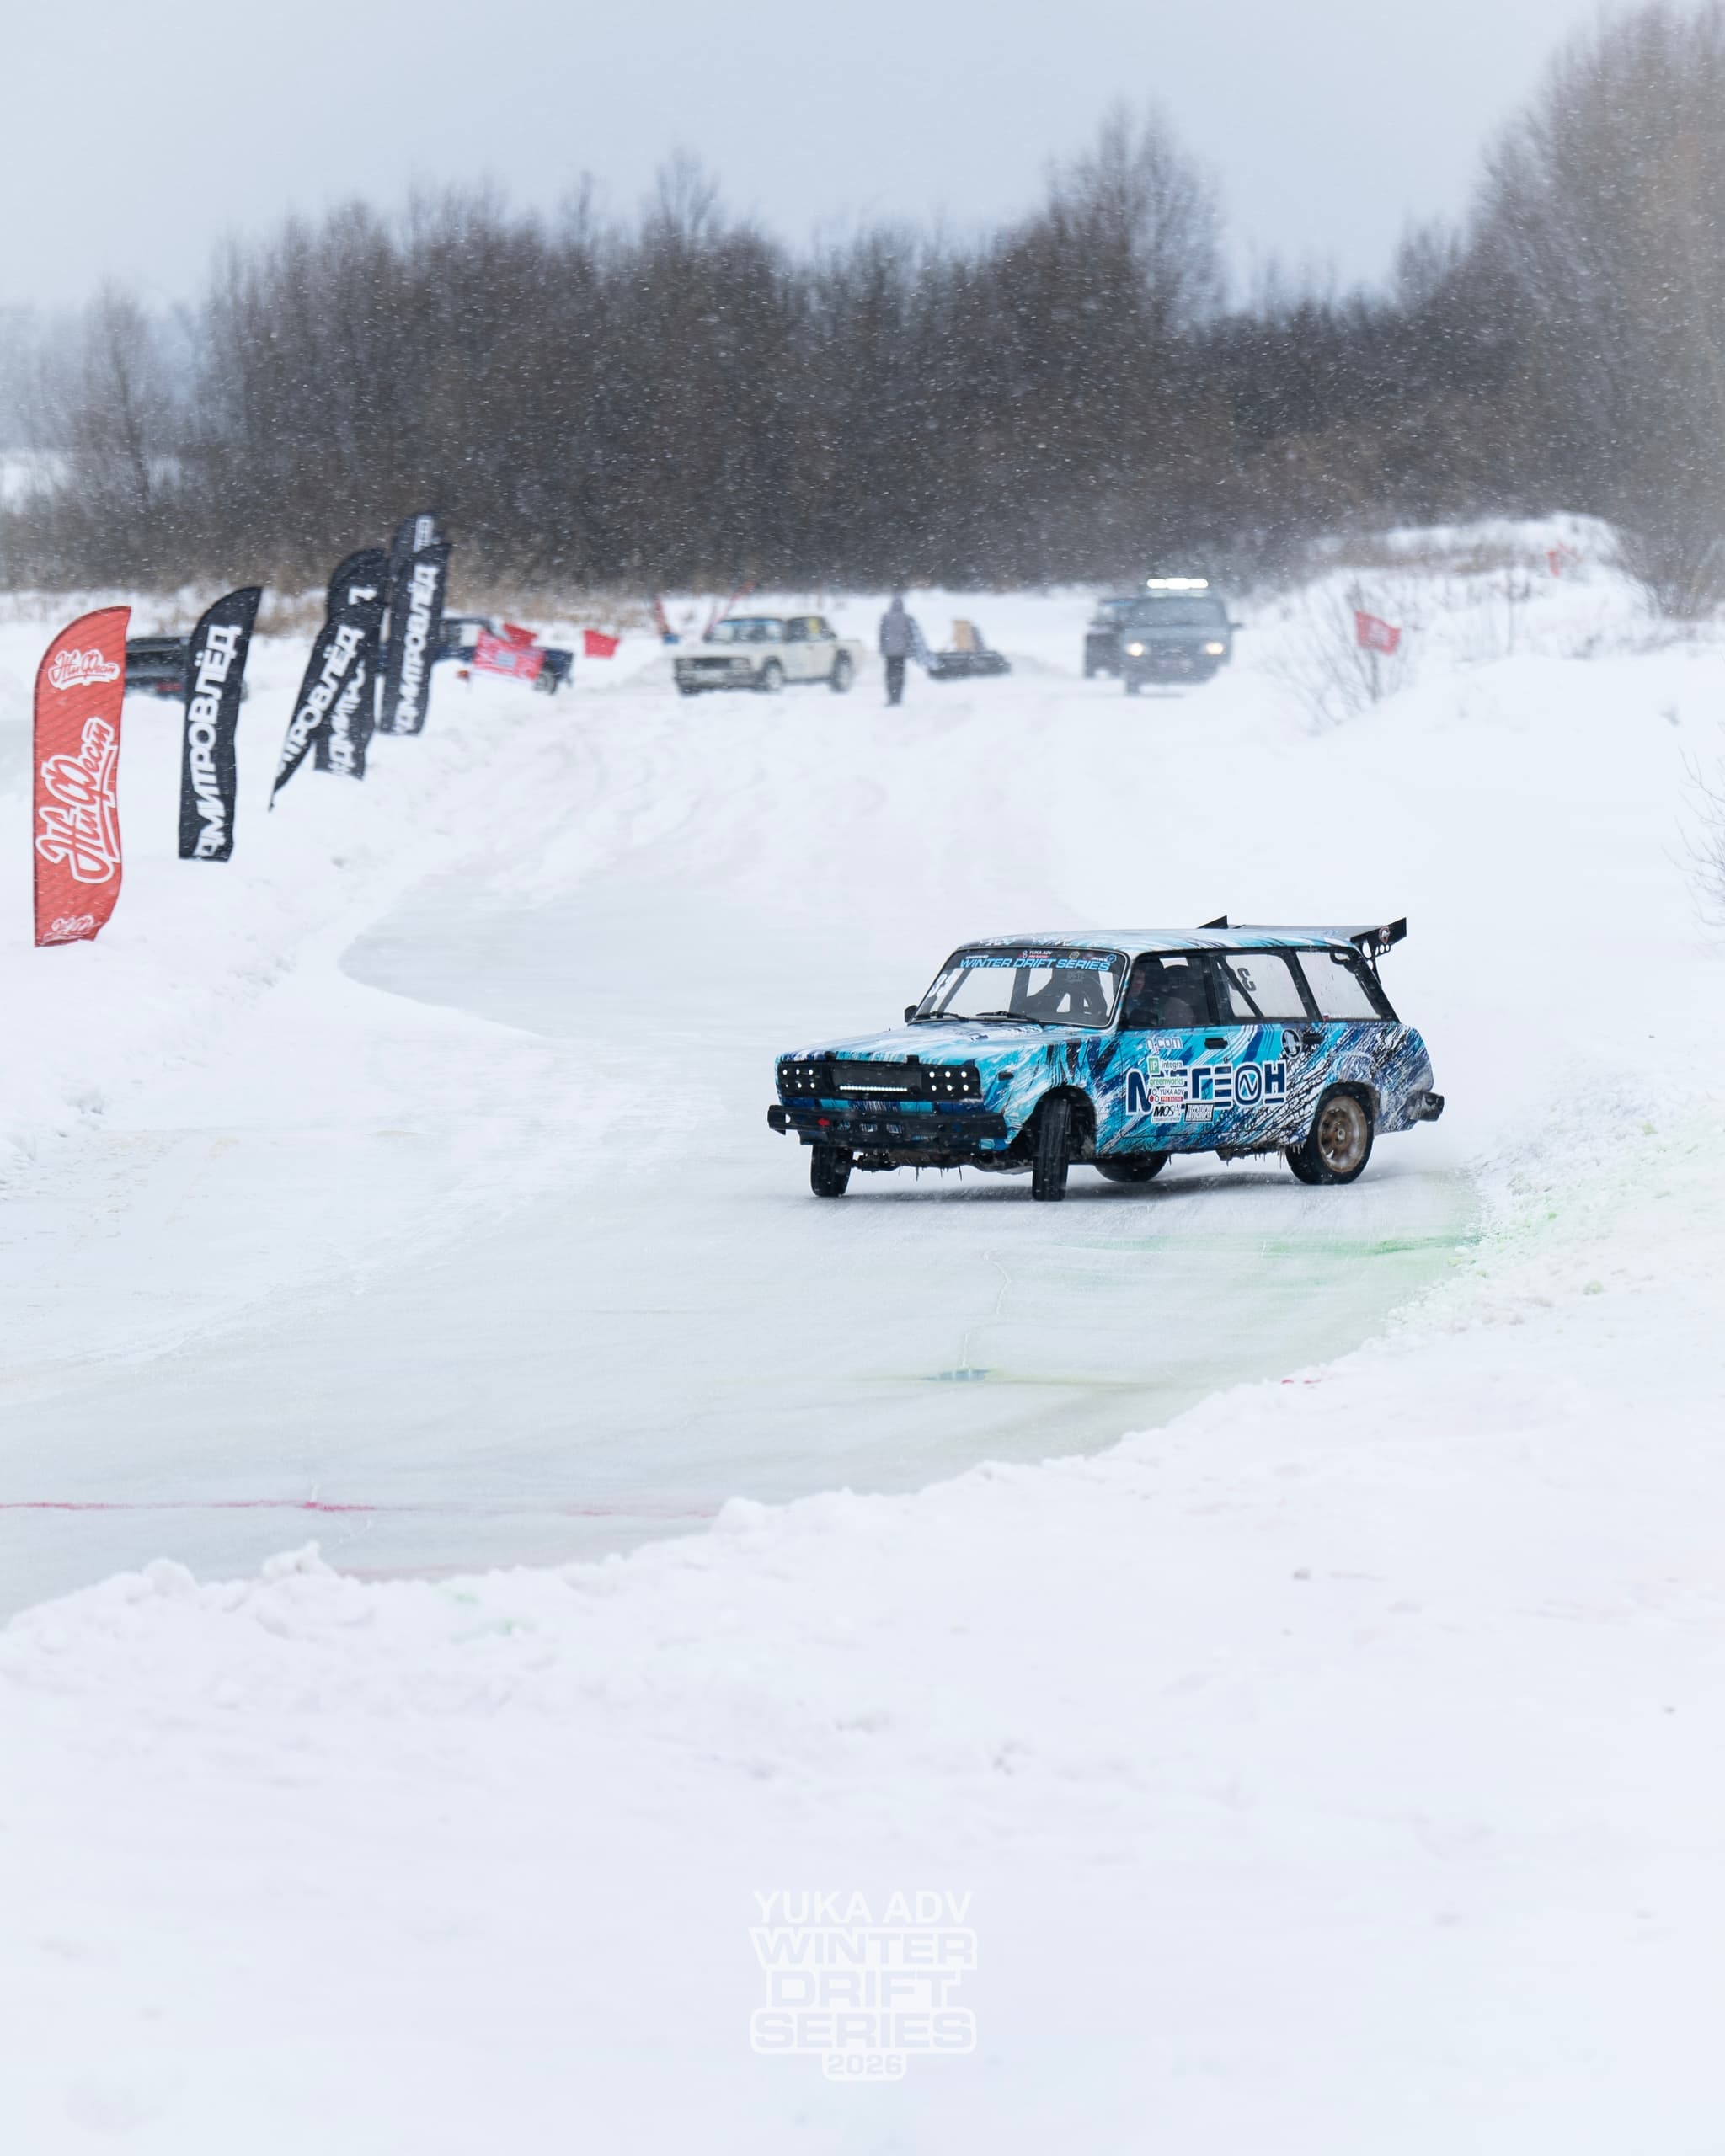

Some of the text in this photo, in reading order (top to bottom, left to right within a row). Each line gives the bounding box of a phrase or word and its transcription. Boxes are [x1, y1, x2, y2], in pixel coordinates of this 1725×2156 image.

[960, 958, 1012, 968] WINTER
[1013, 958, 1055, 969] DRIFT
[1056, 959, 1111, 971] SERIES
[1150, 1077, 1183, 1086] greenworks
